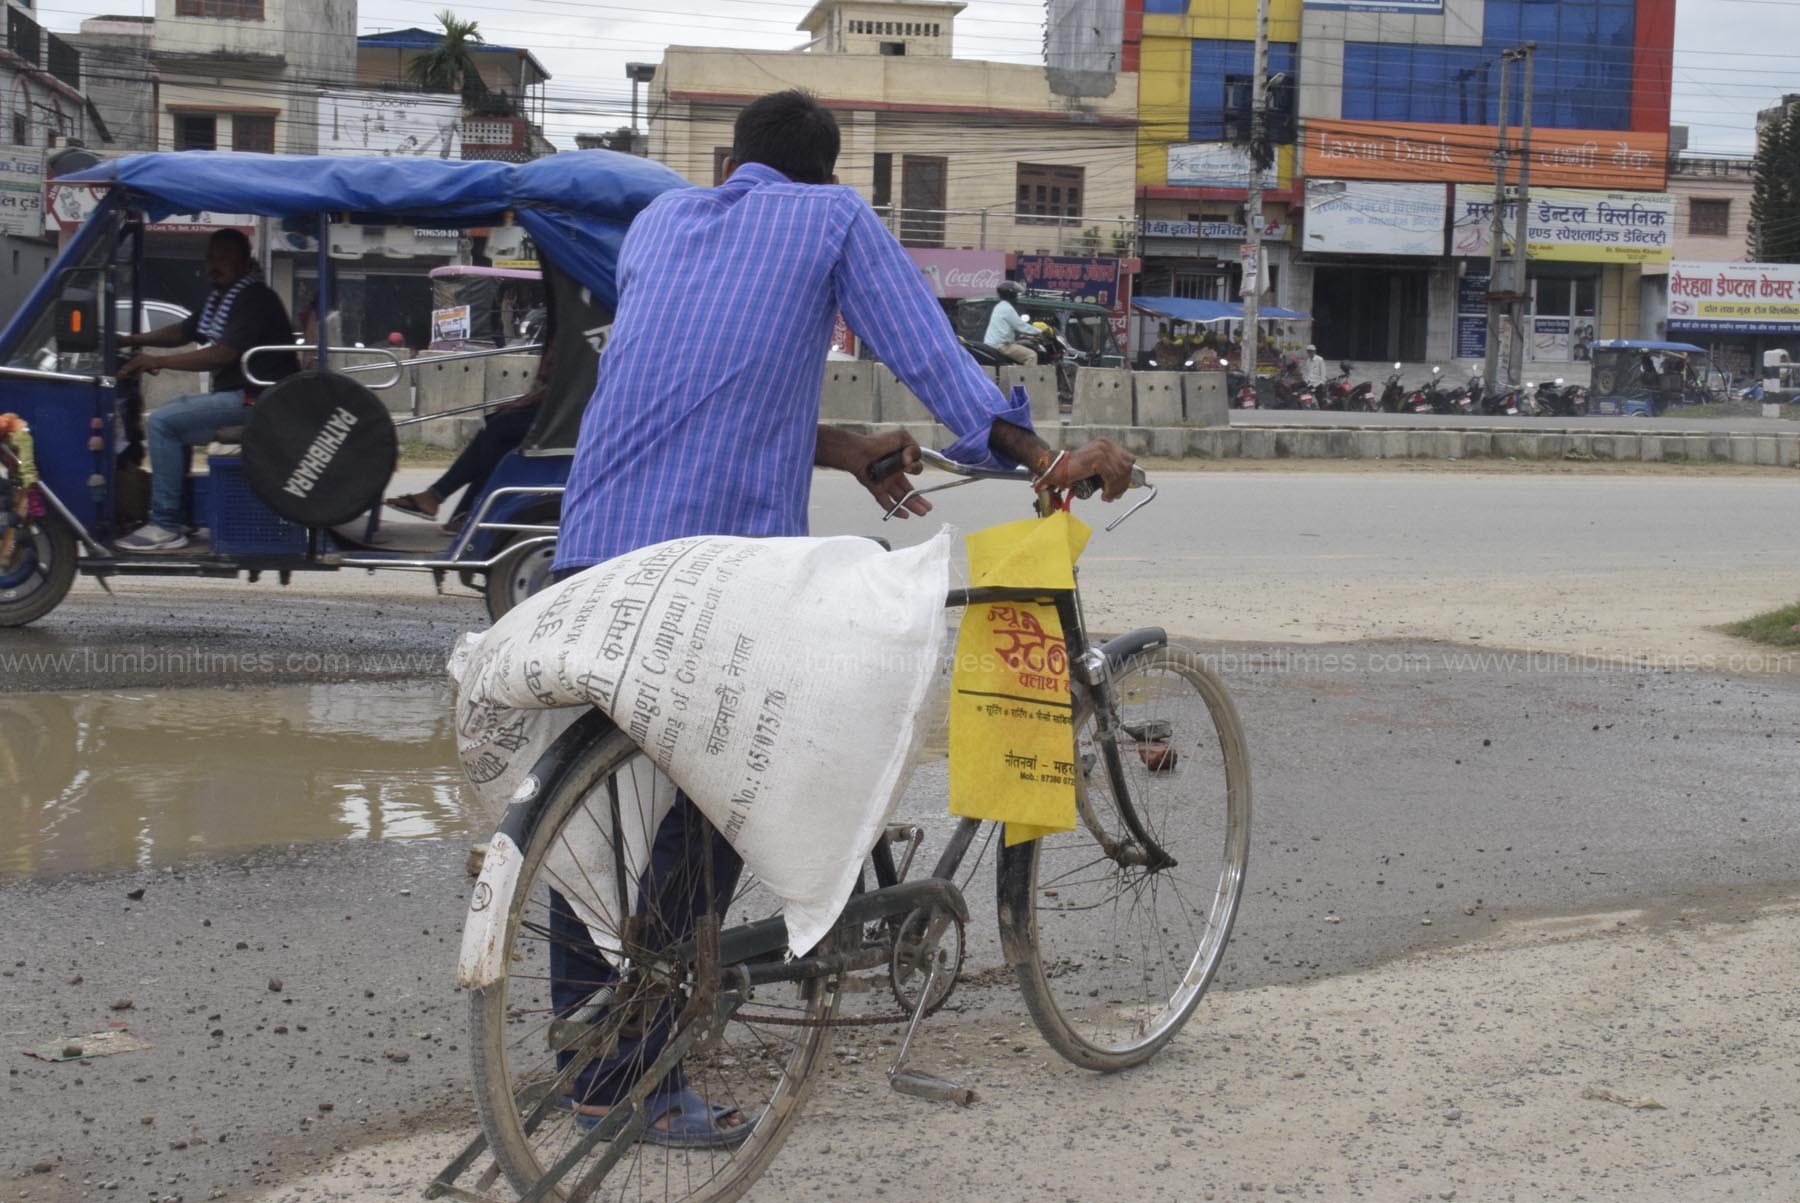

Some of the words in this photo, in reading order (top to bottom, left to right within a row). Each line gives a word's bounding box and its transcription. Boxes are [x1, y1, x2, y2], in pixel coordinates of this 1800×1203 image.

[1528, 227, 1552, 239] एण्ड
[1538, 200, 1589, 224] डेन्टल
[1597, 202, 1667, 227] क्लिनिक
[1671, 270, 1712, 298] भैरहवा
[1716, 273, 1757, 299] डेण्टल
[1760, 273, 1794, 300] केयर
[282, 407, 359, 498] PATHIBHARA
[564, 573, 617, 645] MARKETED
[597, 596, 646, 660] कम्पनी
[641, 591, 697, 675] Company
[675, 587, 723, 684] Government
[987, 605, 1019, 628] न्यू
[722, 632, 755, 676] नेपाल
[629, 677, 661, 746] amagri
[670, 688, 690, 711] of
[747, 688, 787, 772] 65/075/76
[1005, 750, 1038, 770] नौतनवां
